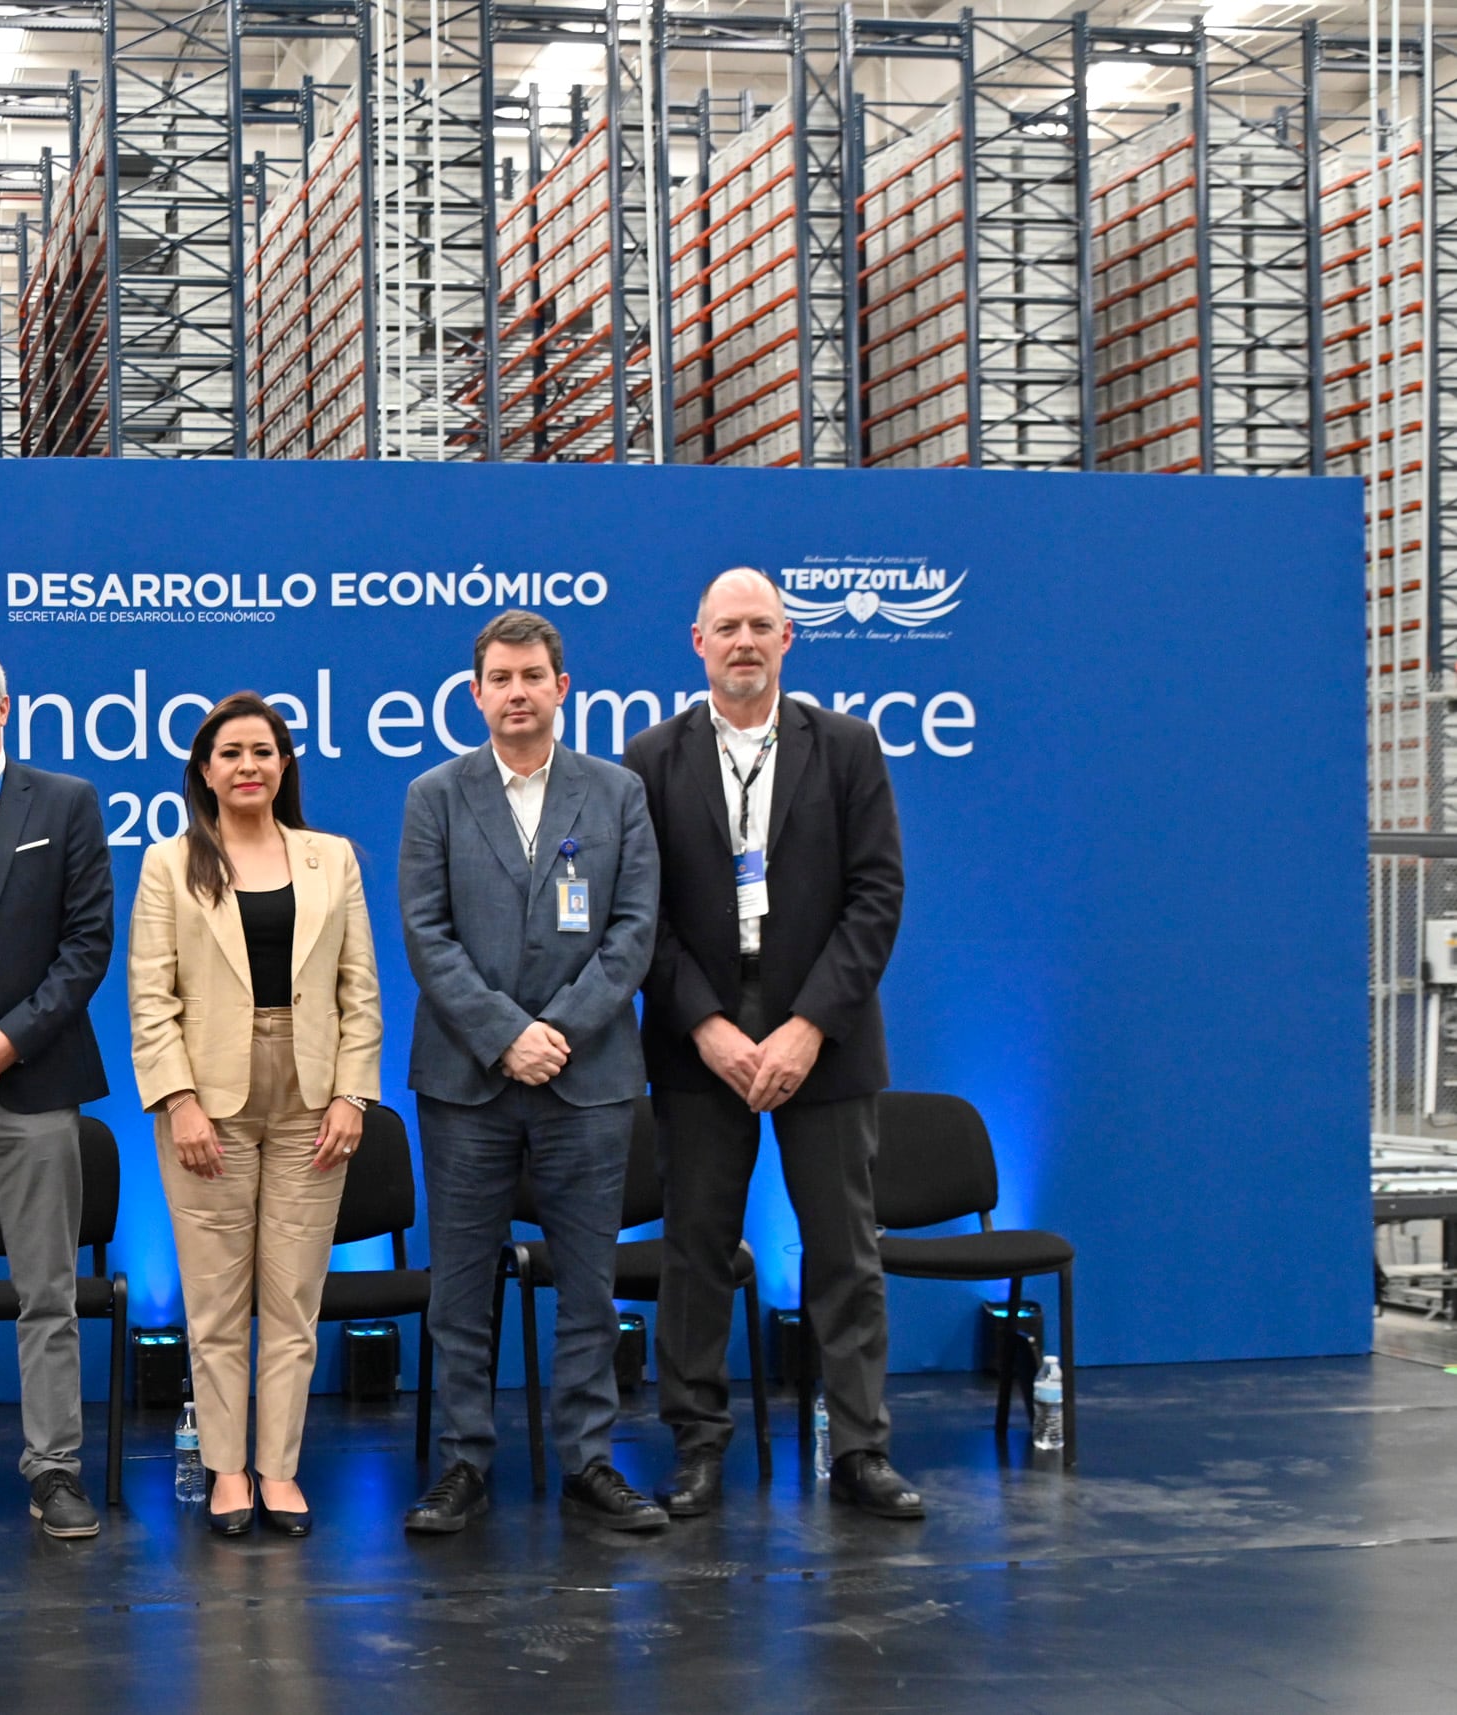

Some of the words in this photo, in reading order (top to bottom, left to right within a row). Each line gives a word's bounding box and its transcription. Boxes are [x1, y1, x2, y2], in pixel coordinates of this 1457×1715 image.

[7, 572, 317, 608] DESARROLLO
[331, 563, 608, 607] ECONÓMICO
[780, 565, 946, 591] TEPOTZOTLÁN
[8, 609, 87, 622] SECRETARÍA
[89, 611, 107, 623] DE
[109, 611, 196, 623] DESARROLLO
[197, 609, 276, 623] ECONÓMICO
